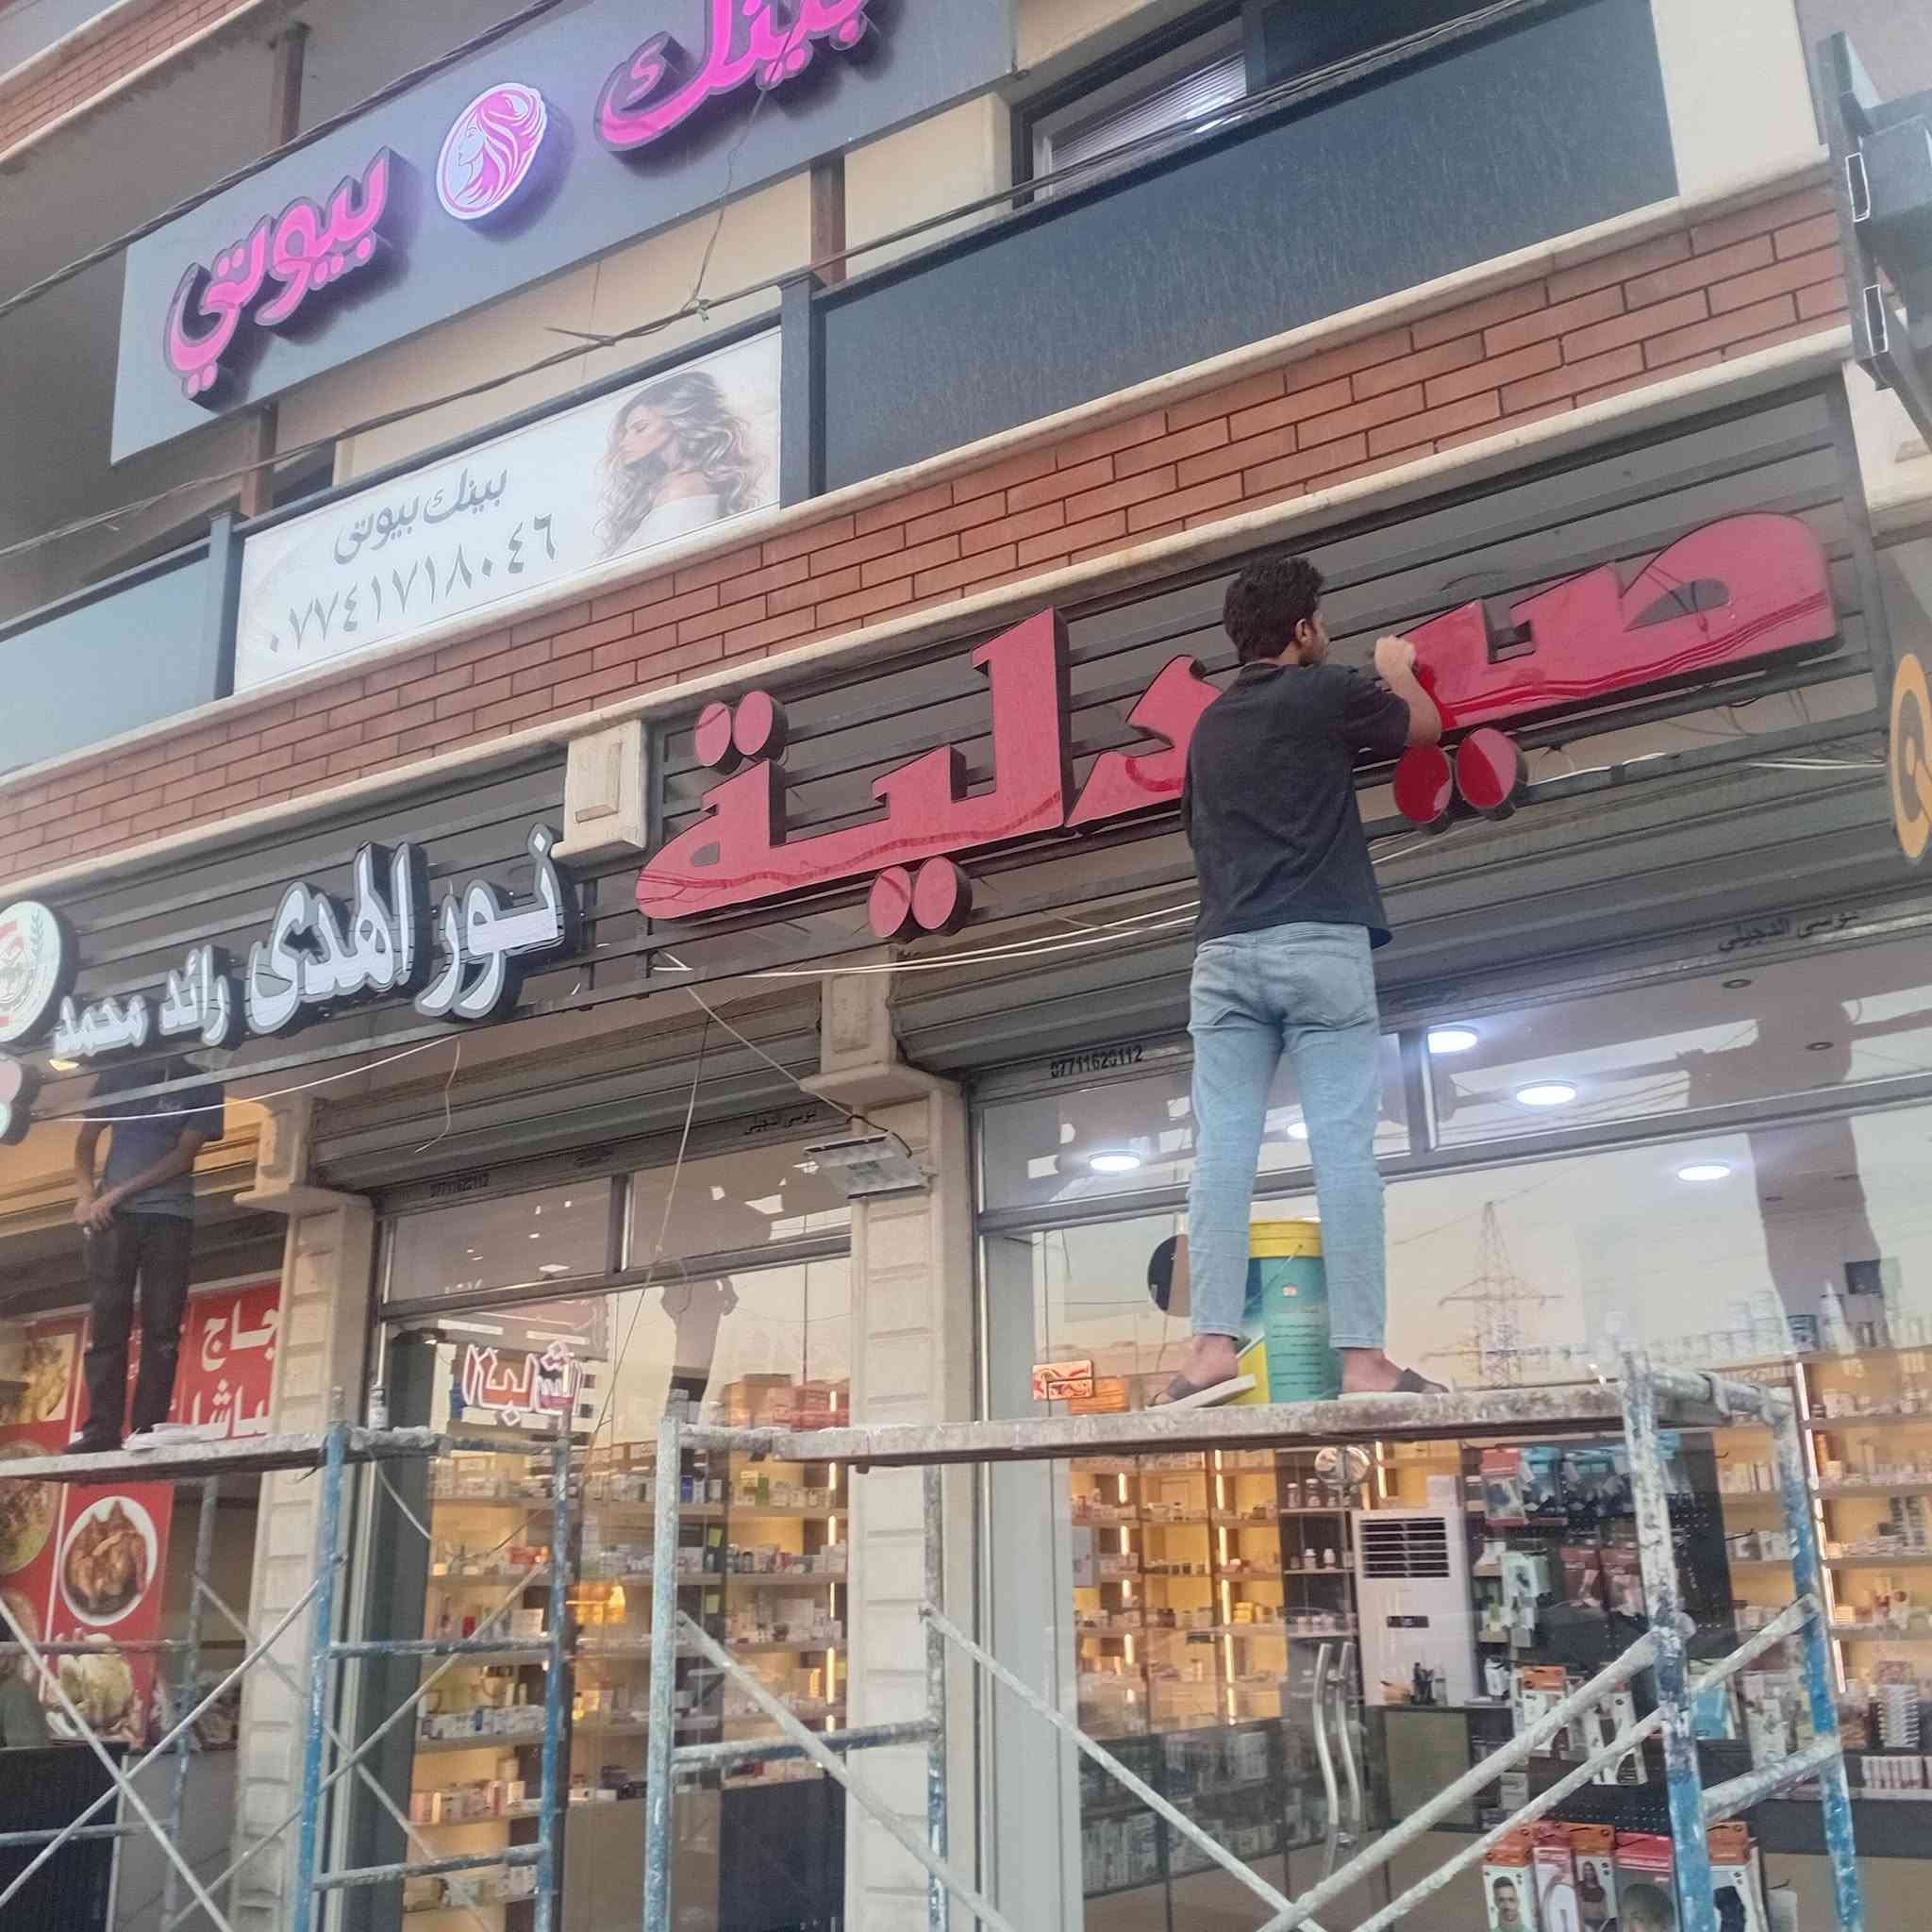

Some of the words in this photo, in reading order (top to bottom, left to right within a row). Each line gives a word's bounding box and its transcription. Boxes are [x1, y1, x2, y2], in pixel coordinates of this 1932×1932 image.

[162, 146, 389, 399] بيوتي
[423, 467, 508, 525] بينك
[270, 513, 557, 653] ٠٧٧٤١٧١٨٠٤٦
[414, 823, 566, 1019] نور
[201, 1299, 278, 1371] جاج
